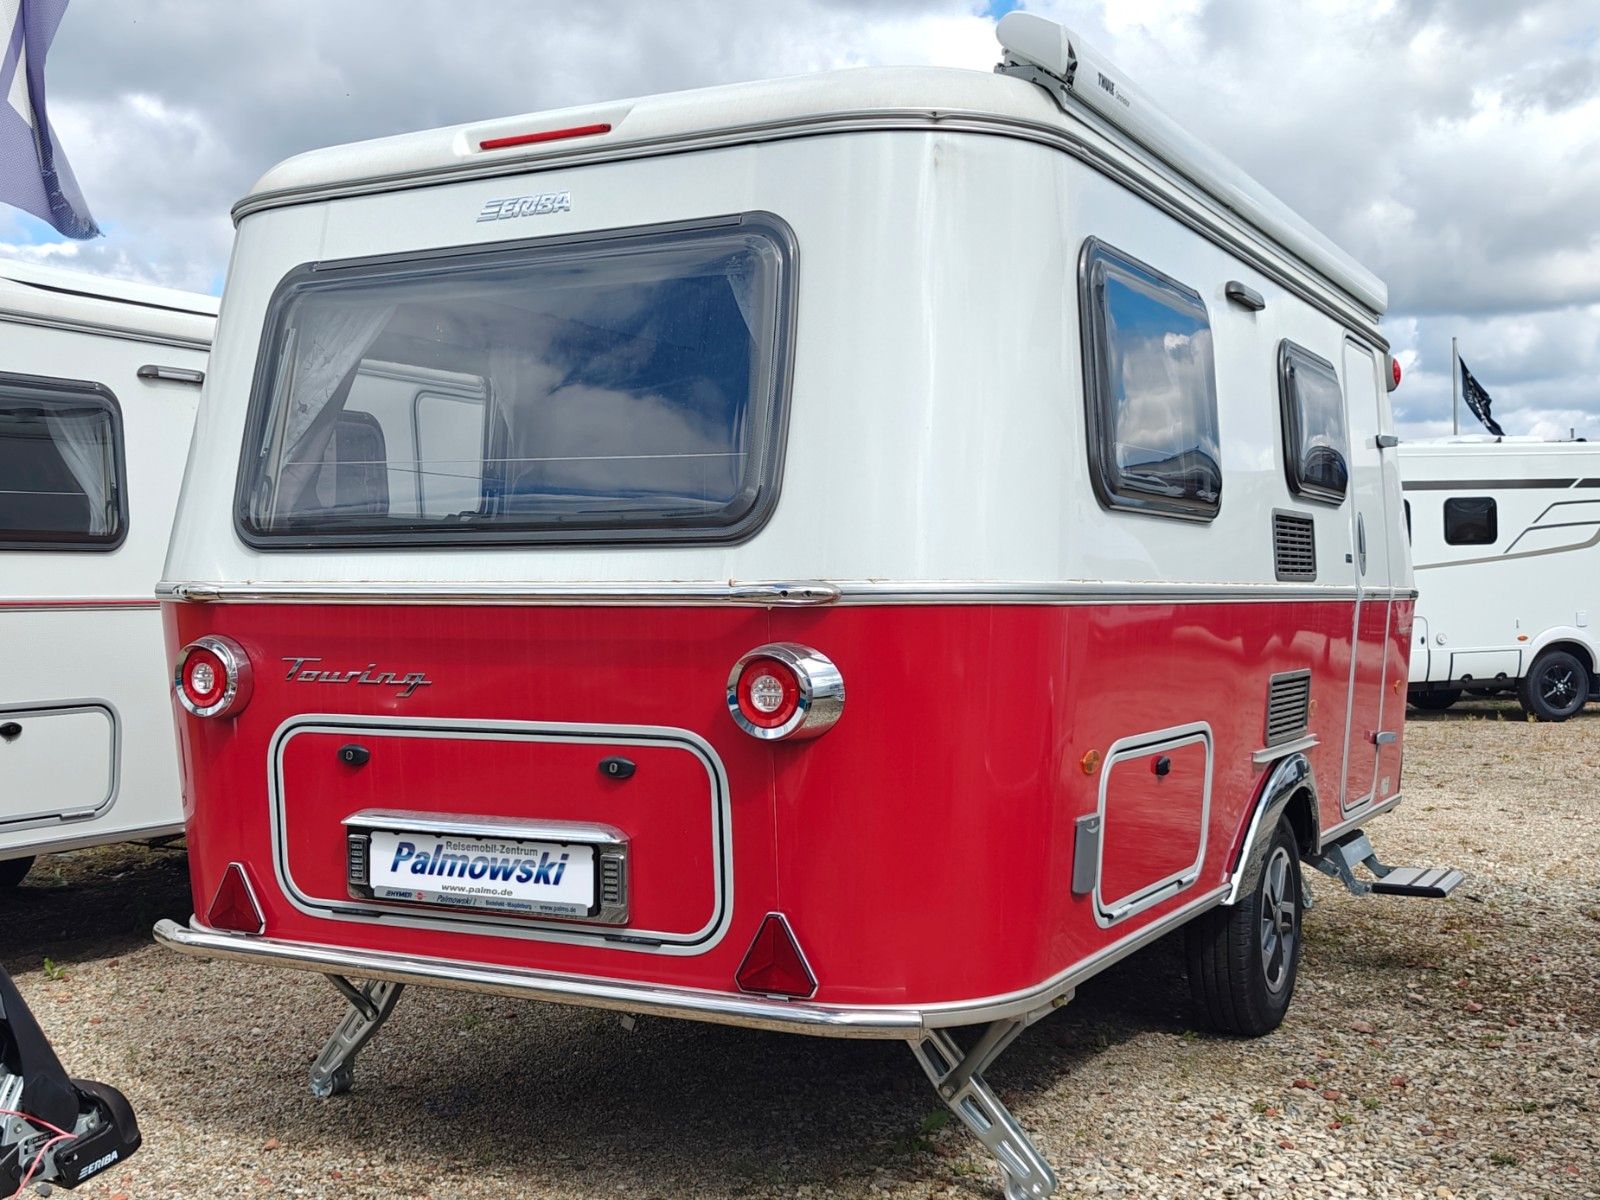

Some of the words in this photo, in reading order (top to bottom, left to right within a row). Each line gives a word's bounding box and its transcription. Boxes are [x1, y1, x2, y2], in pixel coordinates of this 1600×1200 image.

[476, 190, 571, 222] ERIBA
[281, 657, 432, 698] Touring
[390, 841, 570, 886] Palmowski
[445, 840, 538, 857] Reisemobil-Zentrum
[441, 883, 513, 897] www.palmo.de
[77, 1150, 119, 1181] ERIBA
